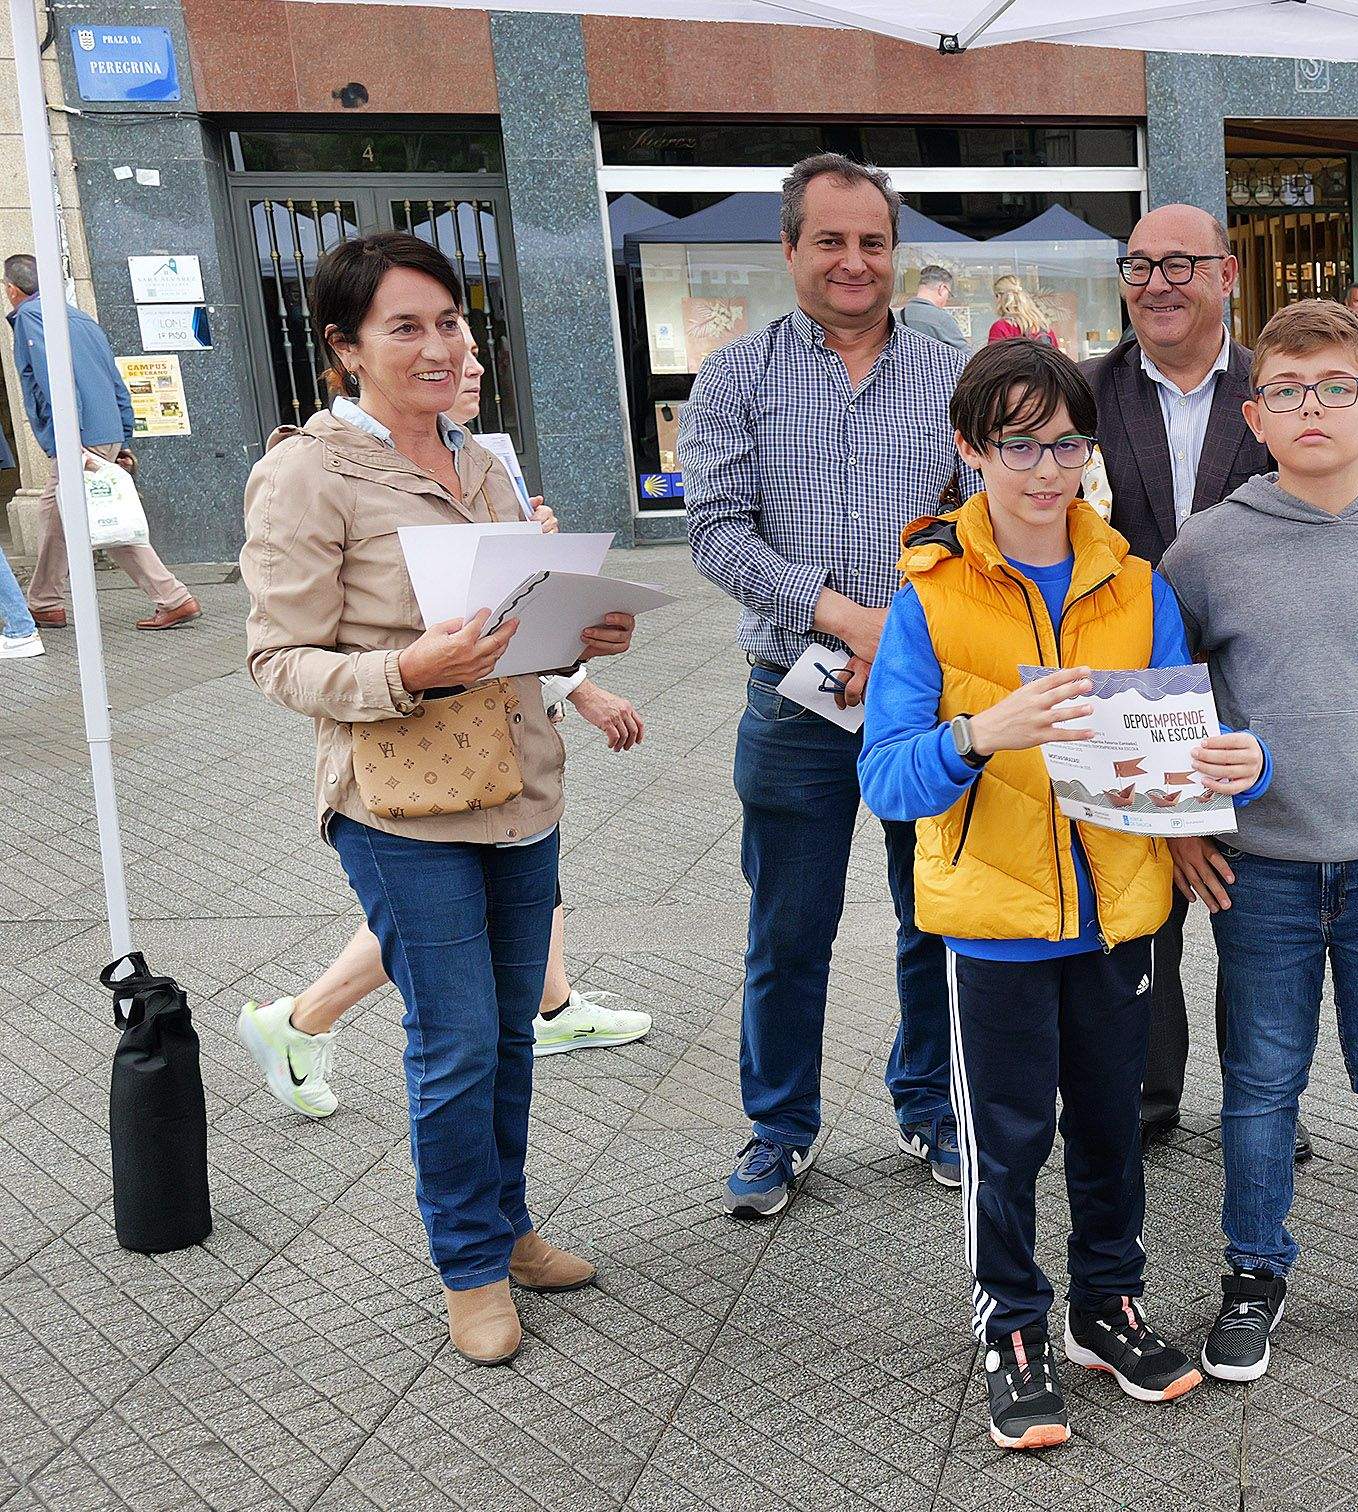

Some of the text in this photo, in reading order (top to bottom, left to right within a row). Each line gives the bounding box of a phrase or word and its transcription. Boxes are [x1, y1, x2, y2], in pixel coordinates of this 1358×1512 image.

[102, 35, 142, 44] PRAZA DA
[89, 61, 162, 74] PEREGRINA
[362, 144, 374, 162] 4
[168, 331, 187, 340] PISO
[127, 363, 167, 371] CAMPUS
[1123, 709, 1206, 729] DEPOEMPRENDE
[1150, 729, 1166, 743] NA
[1167, 725, 1209, 742] ESCOLA
